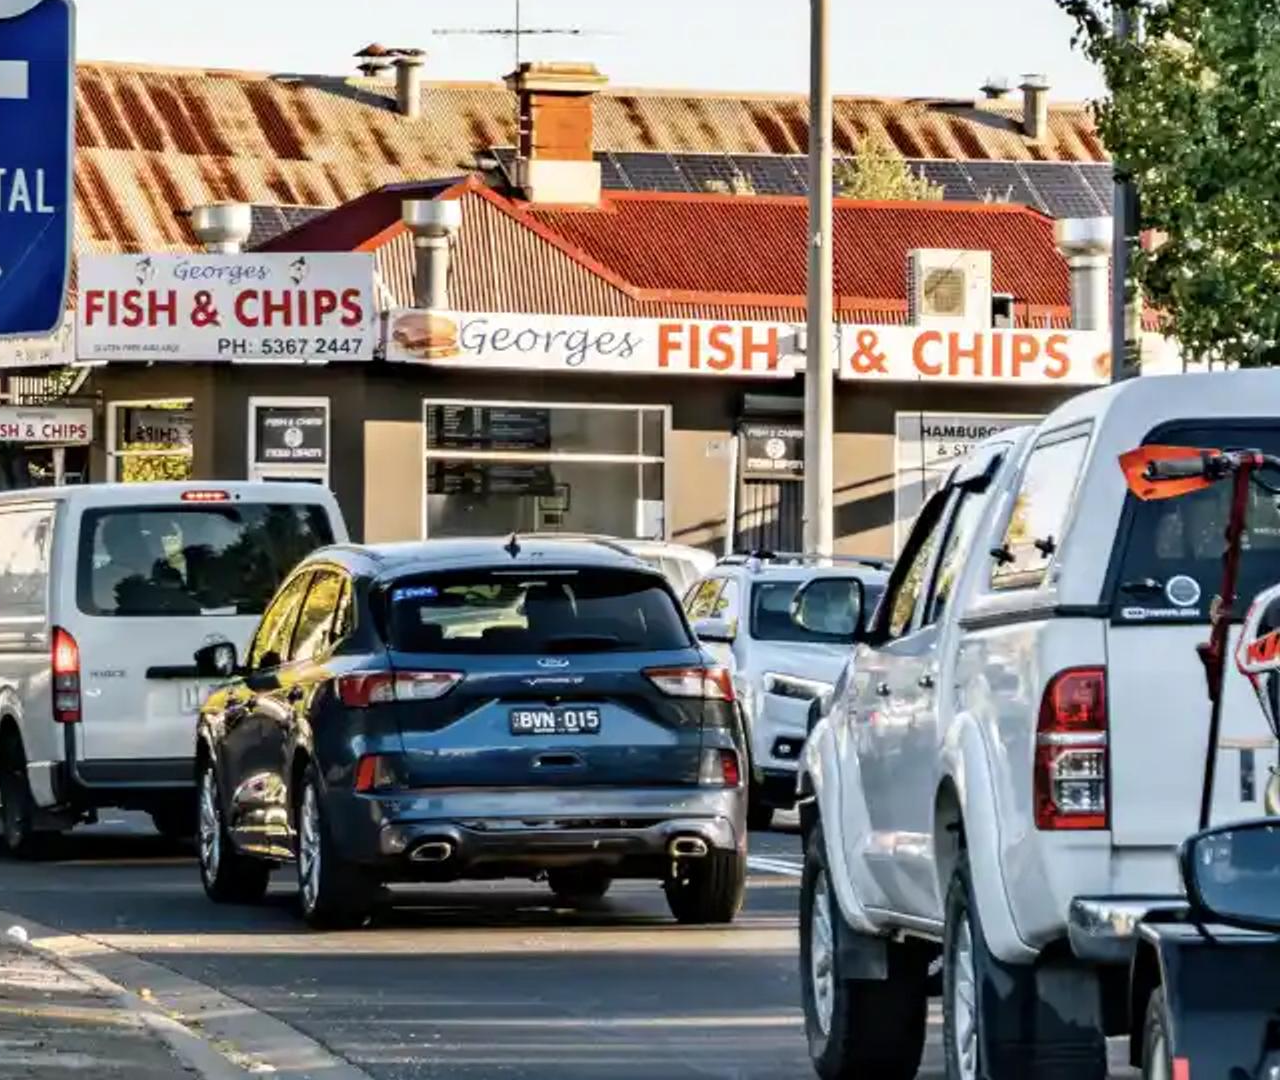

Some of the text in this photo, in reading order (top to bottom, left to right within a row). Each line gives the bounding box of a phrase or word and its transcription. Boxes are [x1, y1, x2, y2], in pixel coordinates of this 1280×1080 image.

[172, 255, 271, 286] Georges
[84, 287, 363, 328] FISH & CHIPS
[217, 338, 363, 356] PH: 5367 2447
[459, 319, 1071, 379] Georges FISH & CHIPS
[26, 423, 35, 438] &
[41, 423, 88, 439] CHIPS
